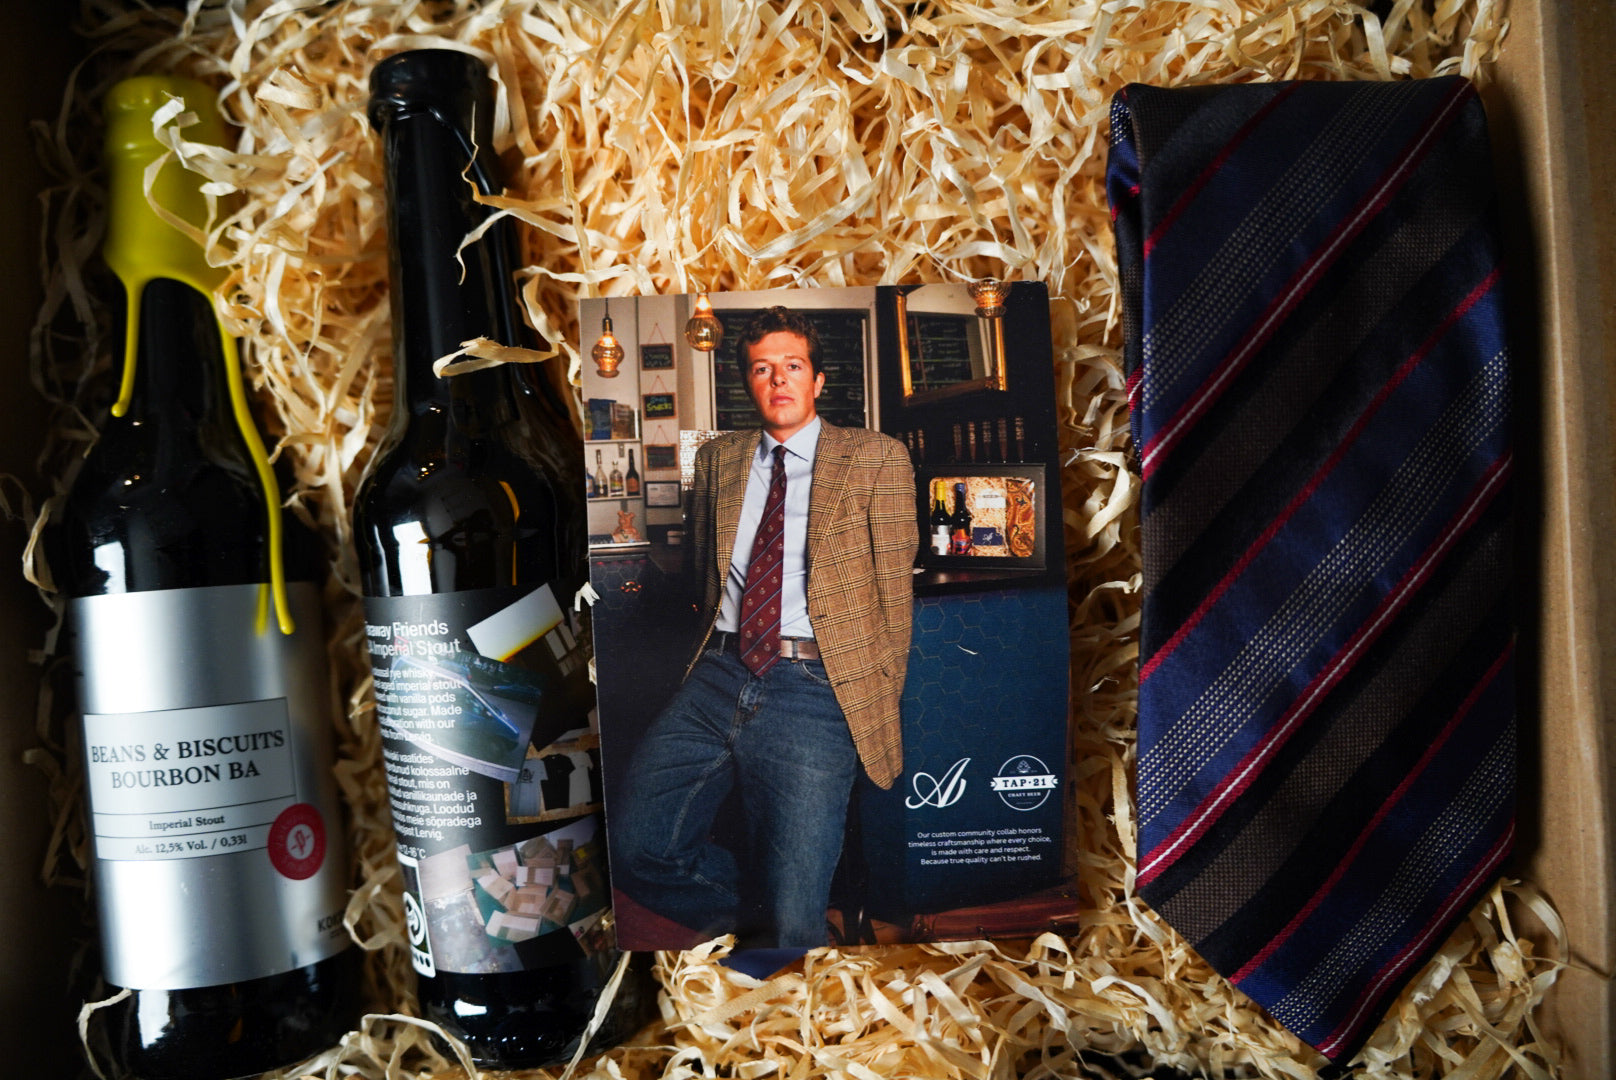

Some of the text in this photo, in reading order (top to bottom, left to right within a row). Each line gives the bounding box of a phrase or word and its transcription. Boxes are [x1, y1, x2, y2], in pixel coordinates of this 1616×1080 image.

[392, 620, 449, 637] Friends
[416, 638, 461, 656] Stout
[396, 680, 431, 693] imperial
[432, 679, 462, 690] stout
[399, 691, 427, 703] vanilla
[428, 692, 456, 704] pods
[402, 707, 430, 718] sugar.
[431, 704, 462, 716] Made
[415, 718, 435, 729] with
[437, 719, 456, 728] our
[91, 730, 285, 763] BEANS & BISCUITS
[111, 760, 260, 789] BOURBON BA
[410, 765, 470, 776] kolossaalne
[418, 778, 435, 789] mis
[436, 780, 451, 789] on
[465, 790, 478, 803] ja
[432, 803, 475, 815] Loodud
[149, 815, 226, 832] Imperial Stout
[425, 815, 482, 828] sõpradega
[414, 826, 444, 840] Lervig.
[917, 826, 1042, 840] Our custom community collab honors
[155, 842, 184, 855] 12,5%
[186, 840, 208, 851] Vol.
[908, 840, 937, 848] timeless
[937, 838, 985, 849] craftsmanship
[986, 838, 1007, 846] where
[1007, 837, 1027, 846] every
[938, 848, 957, 856] made
[958, 847, 973, 855] with
[973, 847, 989, 855] care
[989, 846, 1003, 854] and
[920, 856, 949, 866] Because
[949, 856, 965, 865] true
[965, 855, 988, 865] quality
[989, 854, 1007, 863] can't
[1006, 853, 1016, 862] be
